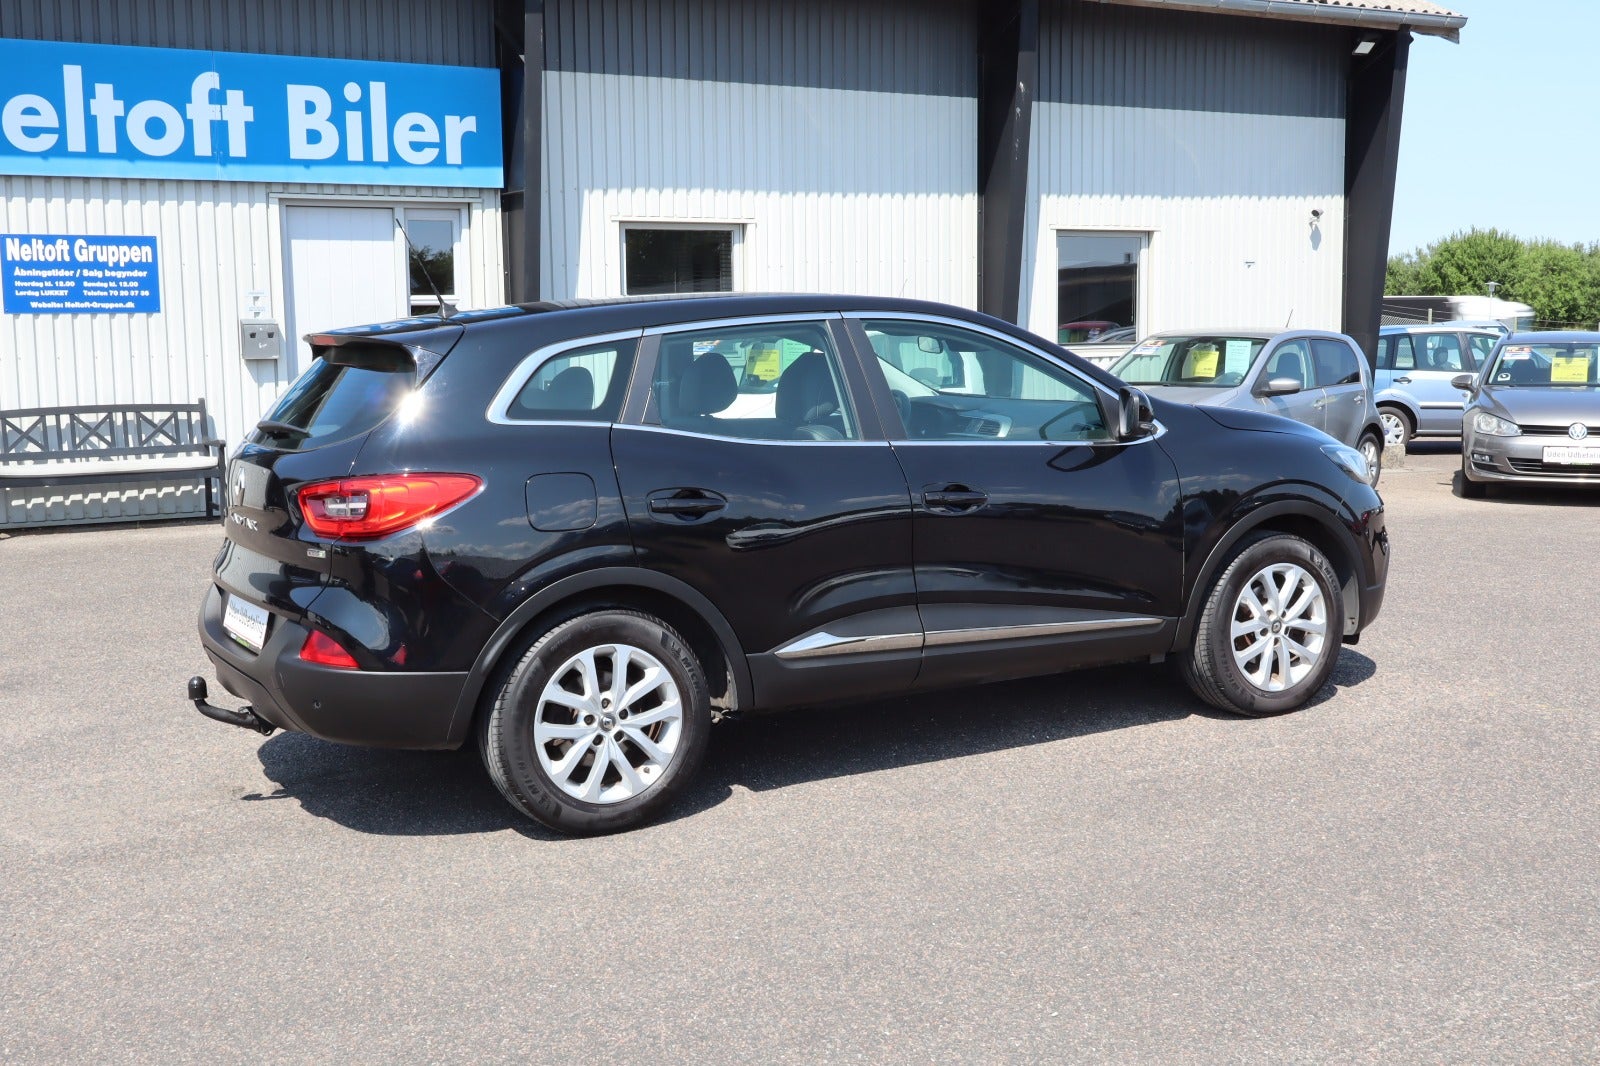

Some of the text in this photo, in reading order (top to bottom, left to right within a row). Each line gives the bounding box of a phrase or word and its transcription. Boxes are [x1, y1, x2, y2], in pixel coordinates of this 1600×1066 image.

[1, 64, 477, 165] eltoft Biler
[5, 238, 153, 267] Neltoft Gruppen
[14, 266, 74, 277] Åbningstider
[82, 269, 103, 278] Salg
[105, 269, 148, 279] begynder
